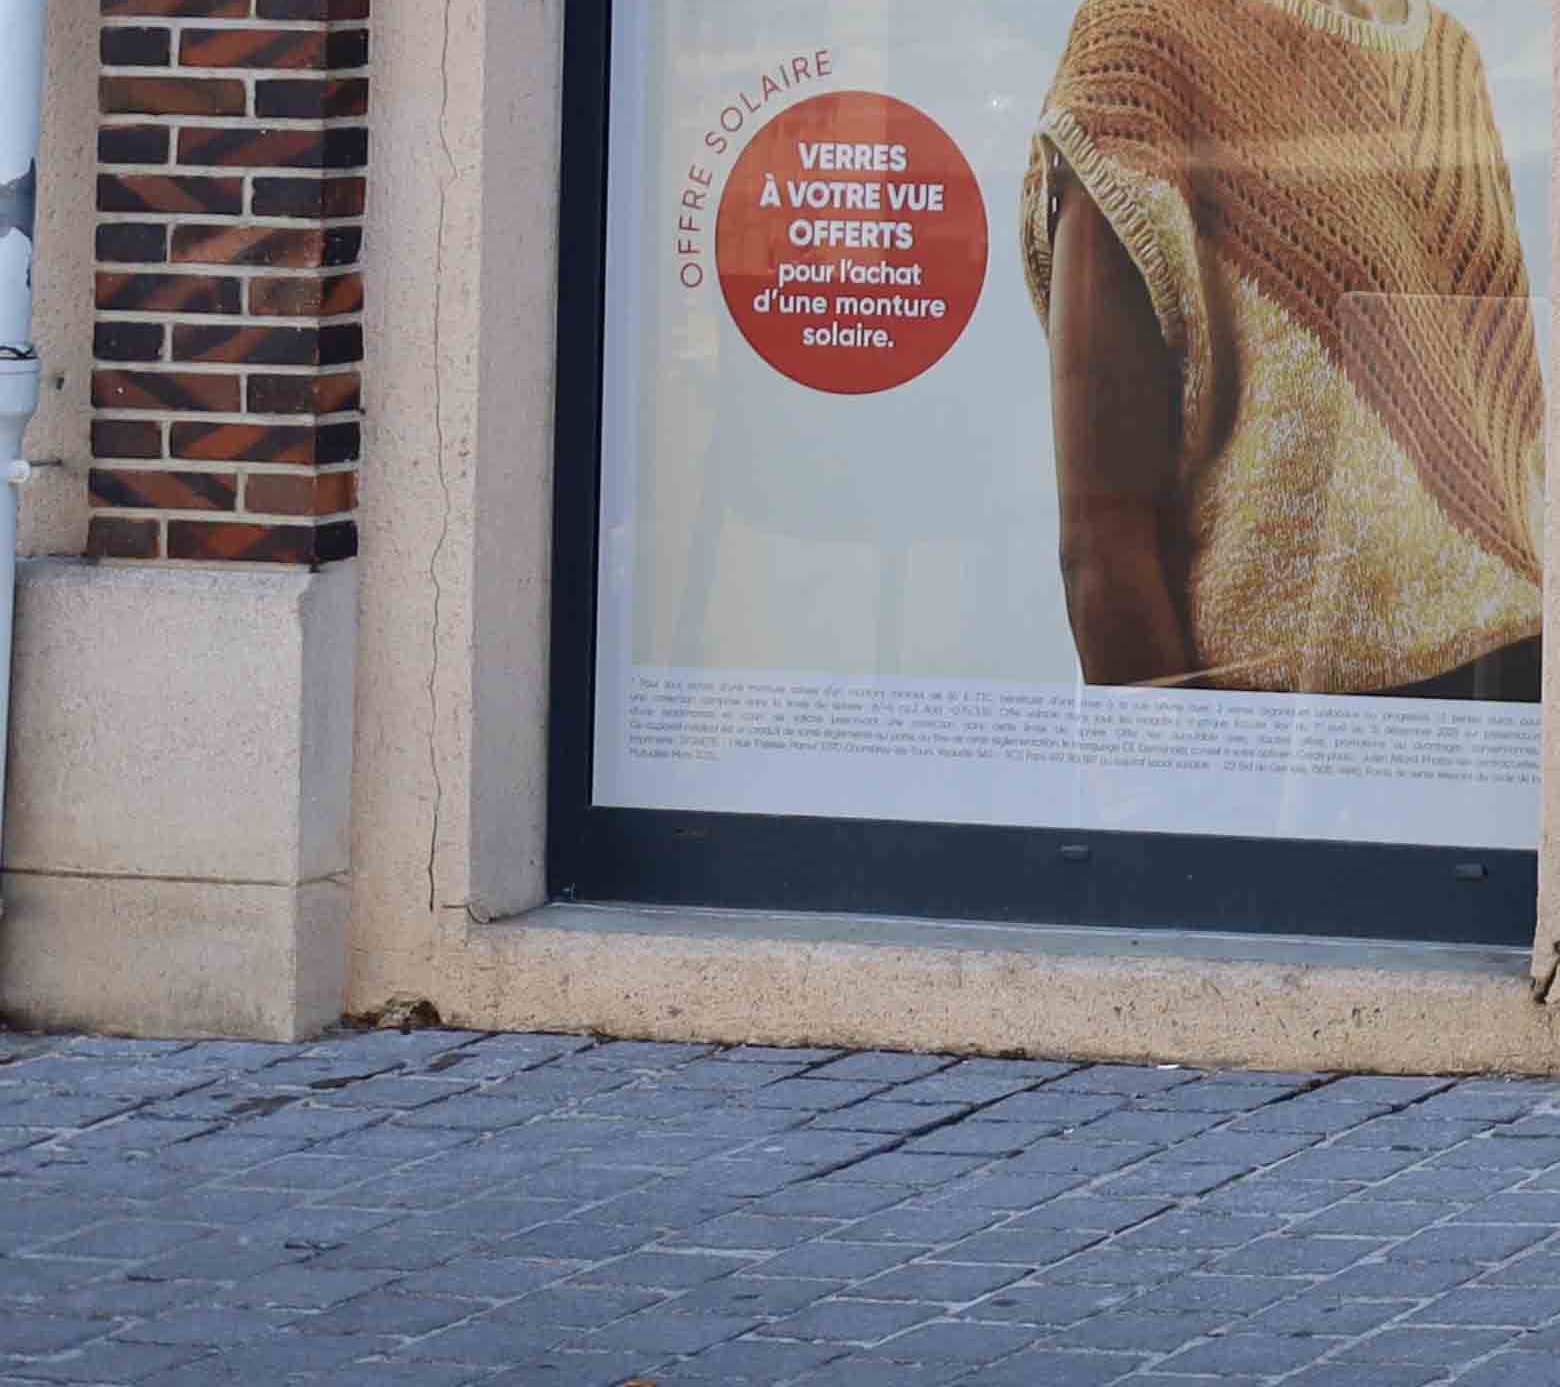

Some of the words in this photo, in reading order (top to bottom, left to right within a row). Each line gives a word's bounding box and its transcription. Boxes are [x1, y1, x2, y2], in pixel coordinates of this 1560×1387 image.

[677, 163, 713, 289] OFFRE
[704, 49, 833, 155] SOLAIRE
[798, 143, 907, 172] VERRES
[759, 173, 782, 208] À
[787, 181, 881, 211] VOTRE
[887, 183, 944, 212] VUE
[788, 219, 914, 250] OFFERTS
[777, 263, 833, 288] pour
[839, 259, 922, 286] l'achat
[752, 290, 828, 315] d'une
[835, 293, 947, 319] monture
[802, 321, 895, 349] solaire.
